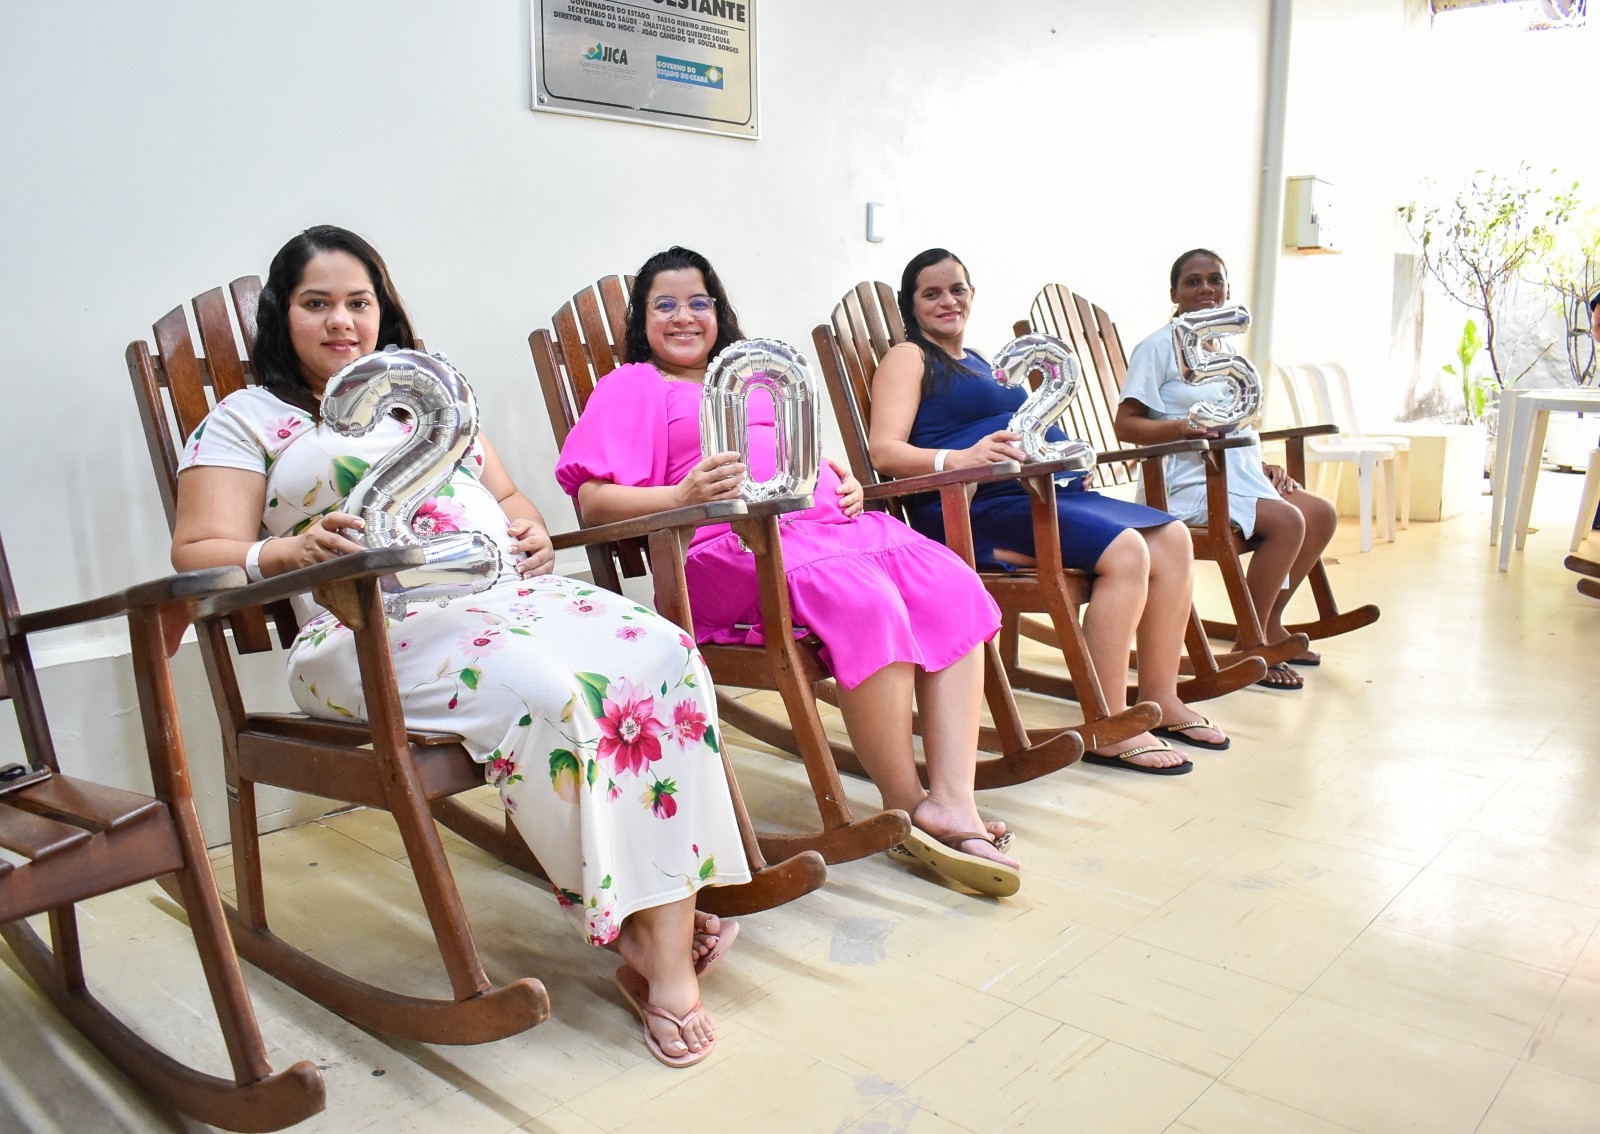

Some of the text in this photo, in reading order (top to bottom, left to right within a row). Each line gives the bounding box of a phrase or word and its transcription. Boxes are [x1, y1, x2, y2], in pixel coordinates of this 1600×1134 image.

[553, 10, 582, 23] DIRETOR
[584, 17, 605, 27] GERAL
[618, 24, 635, 33] HGCC
[697, 39, 717, 49] SOUZA
[718, 44, 739, 54] BORGES
[570, 0, 616, 13] GOVERNADOR
[617, 7, 626, 15] DO
[628, 10, 651, 19] ESTADO
[657, 16, 676, 25] TASSO
[677, 20, 699, 29] RIBEIRO
[700, 25, 729, 36] JEREISSATI
[608, 13, 617, 21] DA
[686, 30, 711, 40] QUEIROZ
[712, 36, 730, 45] SOUSA
[602, 46, 628, 65] JICA
[656, 61, 696, 74] GOVERNO DO
[657, 68, 680, 78] ESTADO
[680, 72, 690, 80] DO
[321, 344, 502, 605] 2
[991, 332, 1097, 470] 2
[1170, 304, 1264, 435] 5
